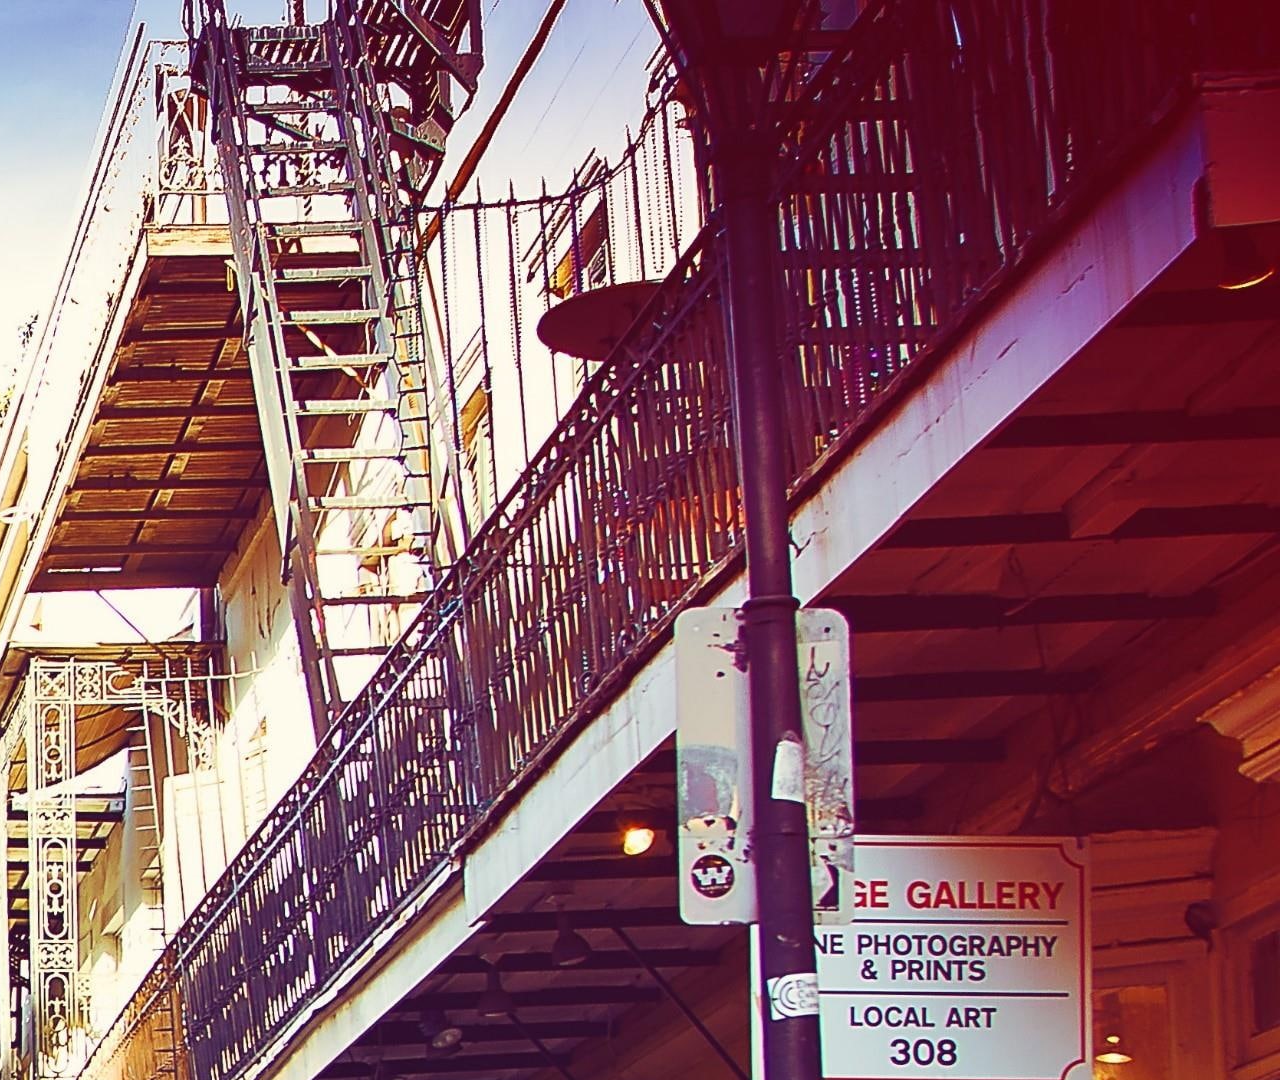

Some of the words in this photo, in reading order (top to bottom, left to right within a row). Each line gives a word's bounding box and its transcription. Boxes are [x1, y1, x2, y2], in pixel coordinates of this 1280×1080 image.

[906, 880, 1064, 911] GALLERY
[814, 933, 845, 955] NE
[856, 934, 1058, 958] PHOTOGRAPHY
[860, 960, 879, 981] &
[890, 960, 987, 982] PRINTS
[849, 1006, 936, 1029] LOCAL
[945, 1006, 997, 1028] ART
[889, 1038, 958, 1067] 308
